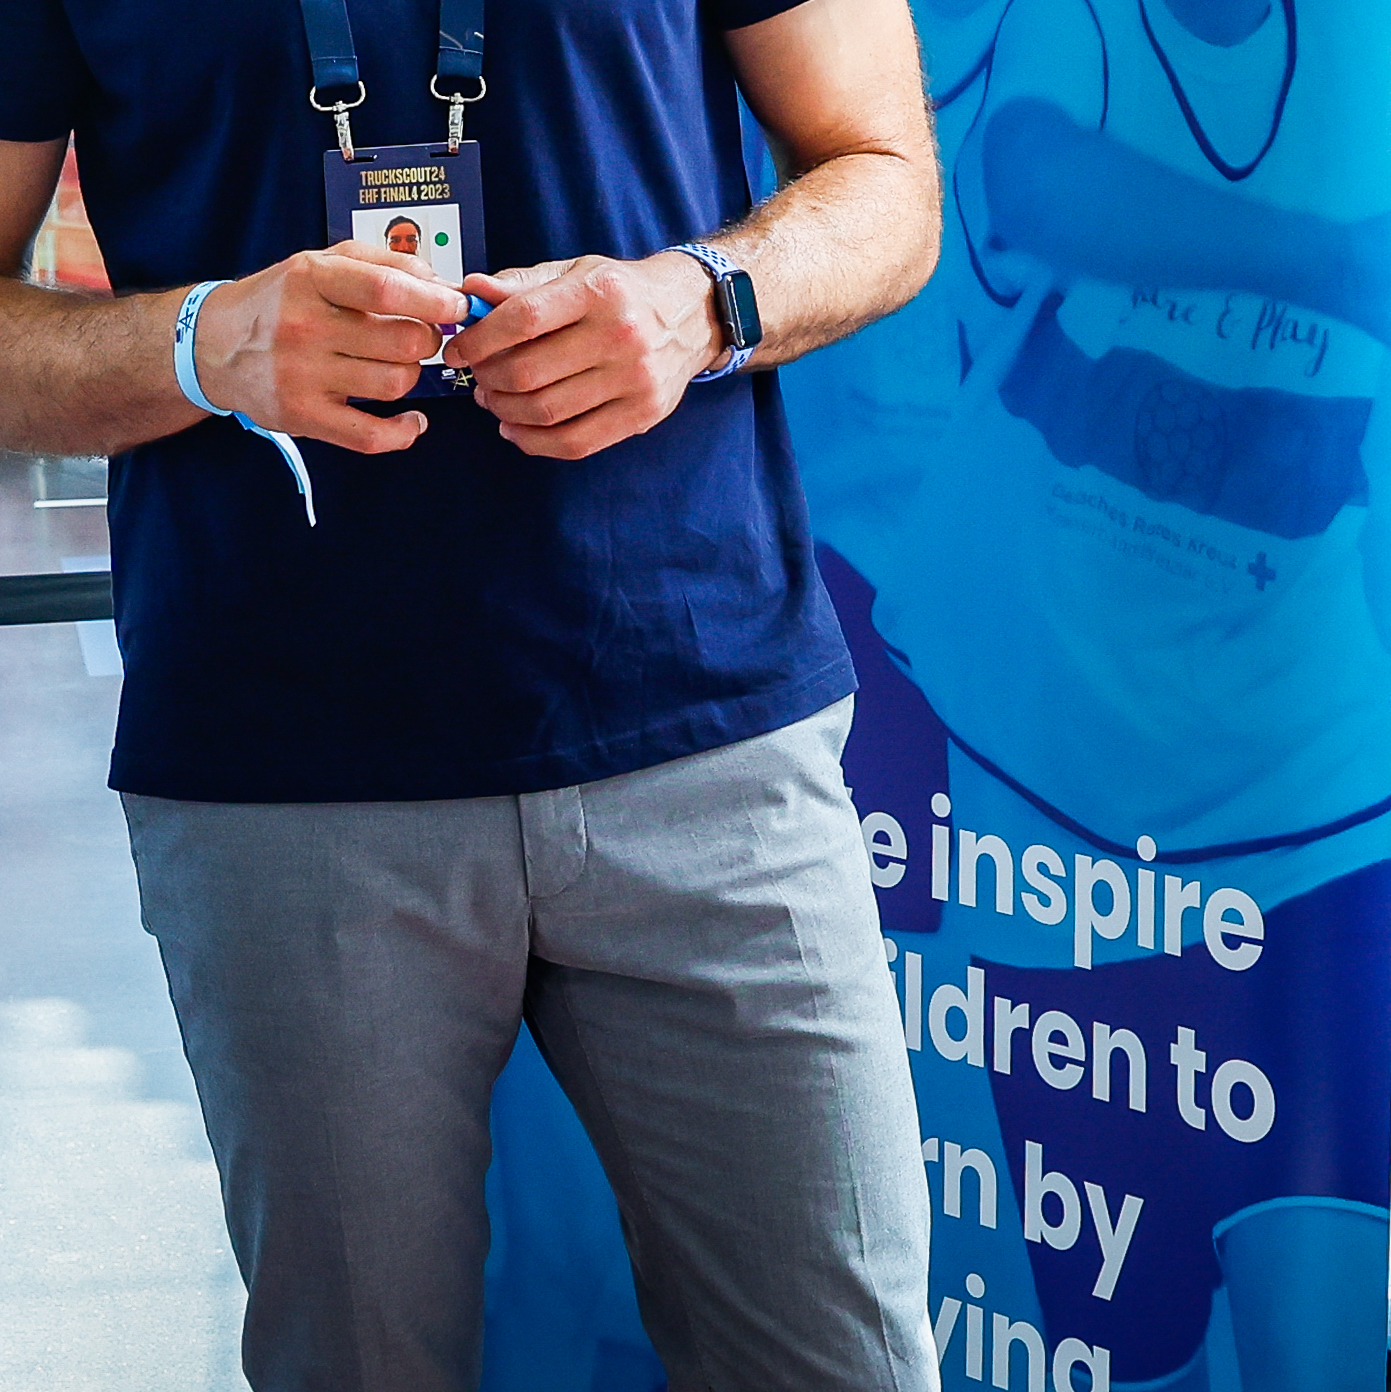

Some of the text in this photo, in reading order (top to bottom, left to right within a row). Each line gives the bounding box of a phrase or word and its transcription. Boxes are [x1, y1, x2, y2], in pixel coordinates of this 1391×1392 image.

[359, 182, 451, 204] EHF FINAL4 2023
[360, 165, 446, 186] TRUCKSCOUT24
[931, 792, 1265, 971] inspire
[1171, 1025, 1276, 1144] to
[1024, 1139, 1145, 1302] by
